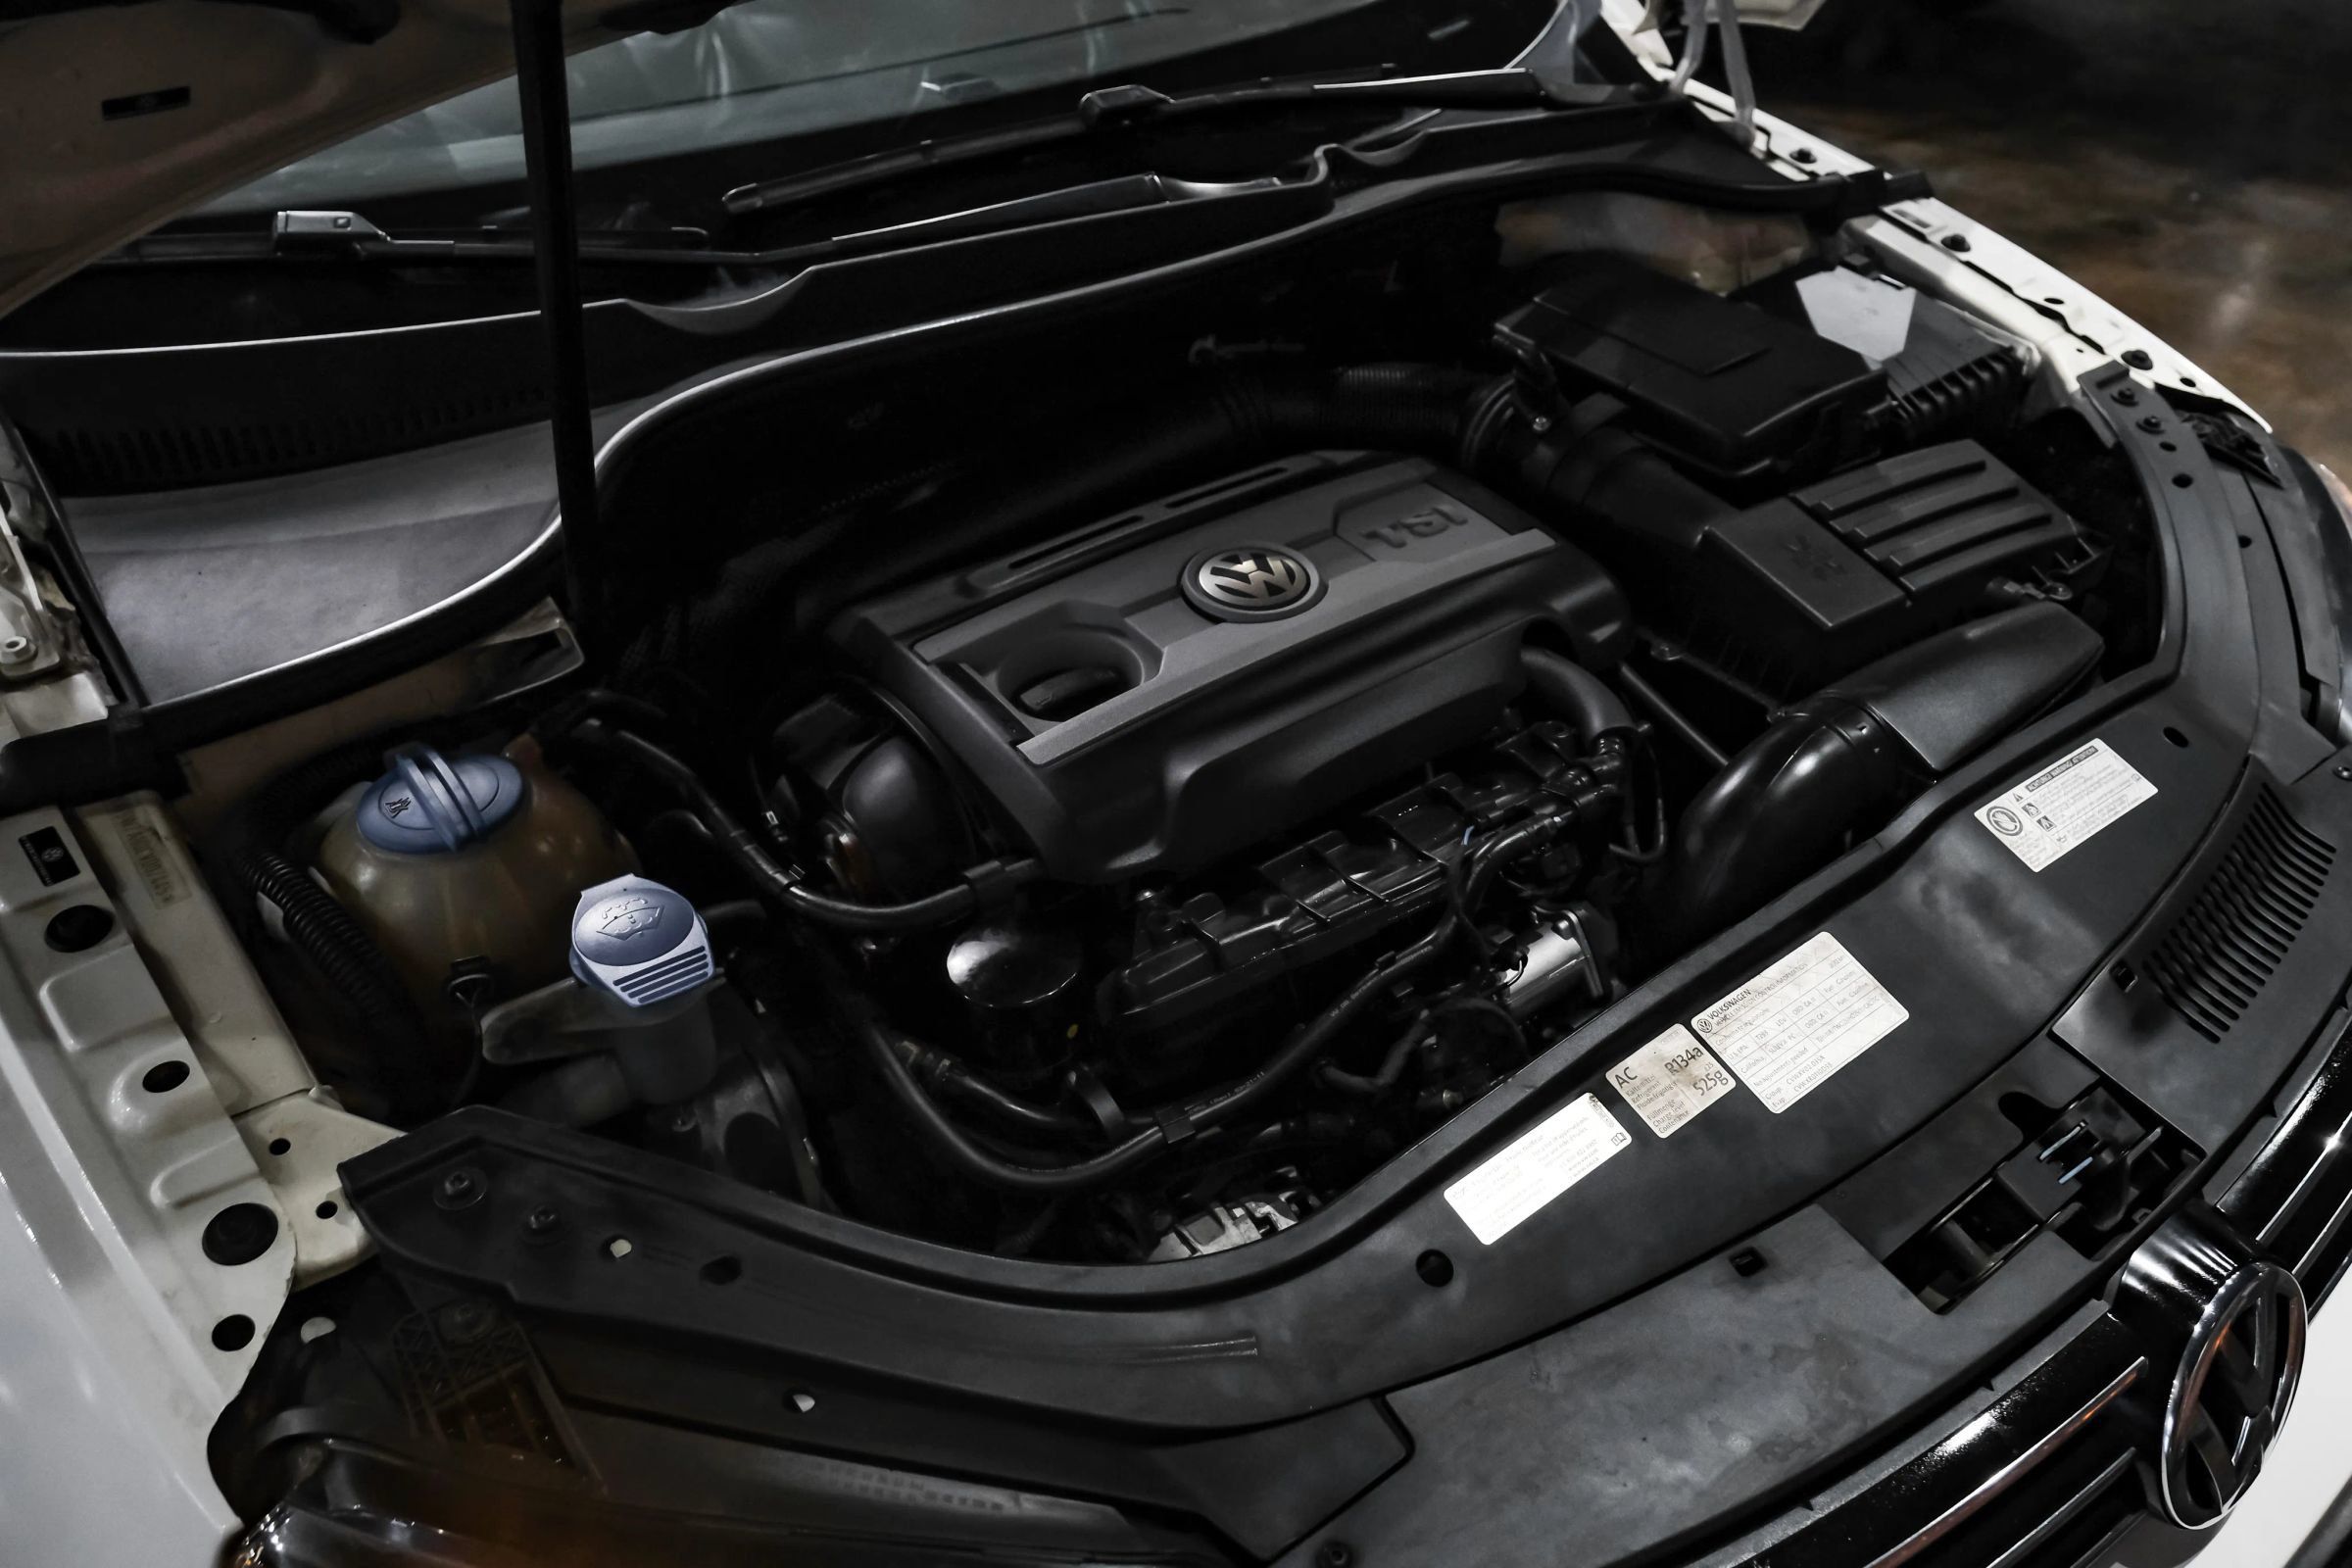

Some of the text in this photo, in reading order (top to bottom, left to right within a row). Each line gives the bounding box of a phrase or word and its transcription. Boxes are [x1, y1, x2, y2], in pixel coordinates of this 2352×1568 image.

[1754, 982, 1779, 1002] CONTROL
[1774, 961, 1809, 987] INFORMATION
[1707, 988, 1752, 1021] VOLKSWAGEN
[1664, 1046, 1704, 1076] R134a
[1613, 1065, 1639, 1090] AC
[1691, 1070, 1730, 1097] 525g
[1631, 1080, 1664, 1106] Refrigerant
[1652, 1101, 1688, 1130] Charge level
